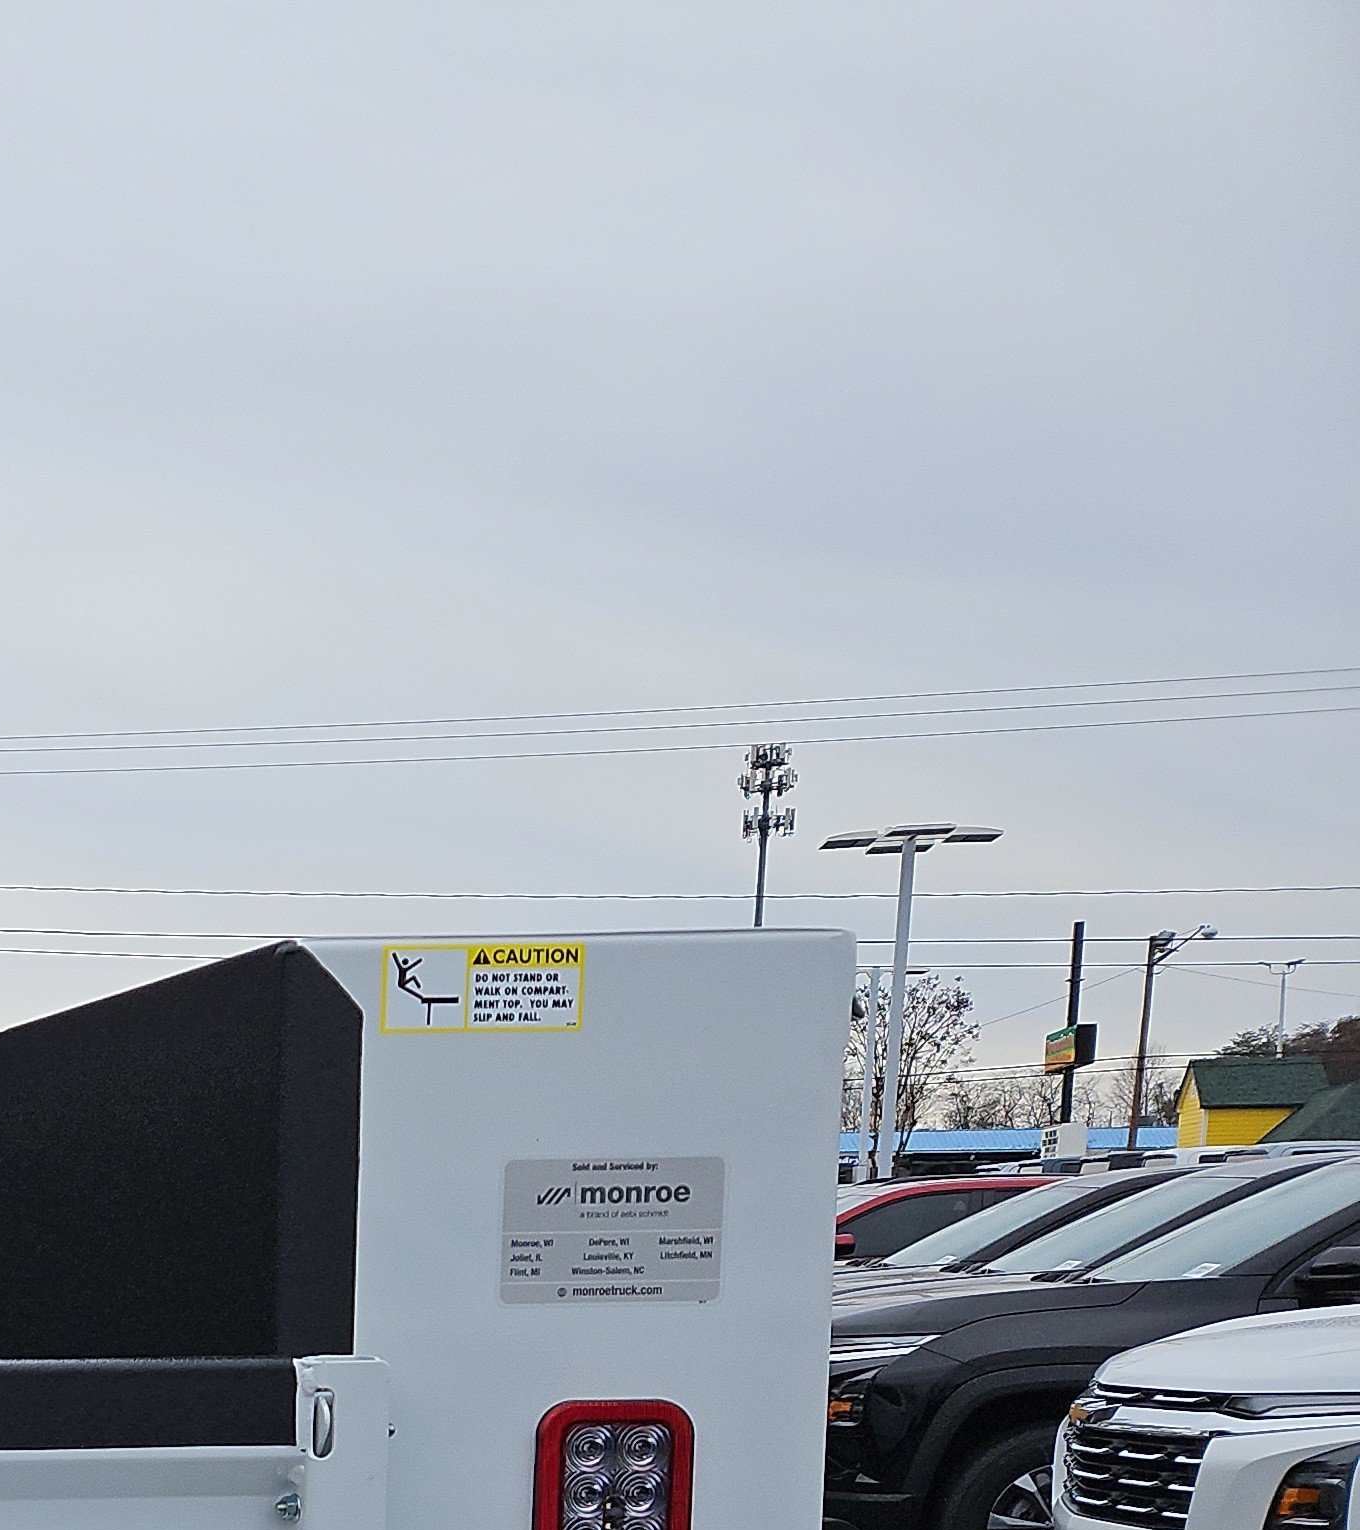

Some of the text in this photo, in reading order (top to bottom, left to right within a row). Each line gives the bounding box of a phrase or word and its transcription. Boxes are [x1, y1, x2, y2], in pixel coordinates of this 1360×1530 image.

[493, 948, 578, 963] CAUTION
[475, 973, 558, 982] DO NOT STAND OR
[475, 985, 569, 996] WALK ON COMPART-
[474, 999, 573, 1009] MENT TOP. YOU MAY
[473, 1012, 541, 1022] SLIP AND FALL.
[592, 1162, 607, 1170] and
[609, 1162, 644, 1170] Serviced
[646, 1162, 658, 1171] by:
[580, 1184, 691, 1204] monroe
[703, 1236, 713, 1244] WI
[624, 1252, 634, 1260] KY
[634, 1266, 644, 1274] NC
[573, 1285, 662, 1296] monroetruck.com
